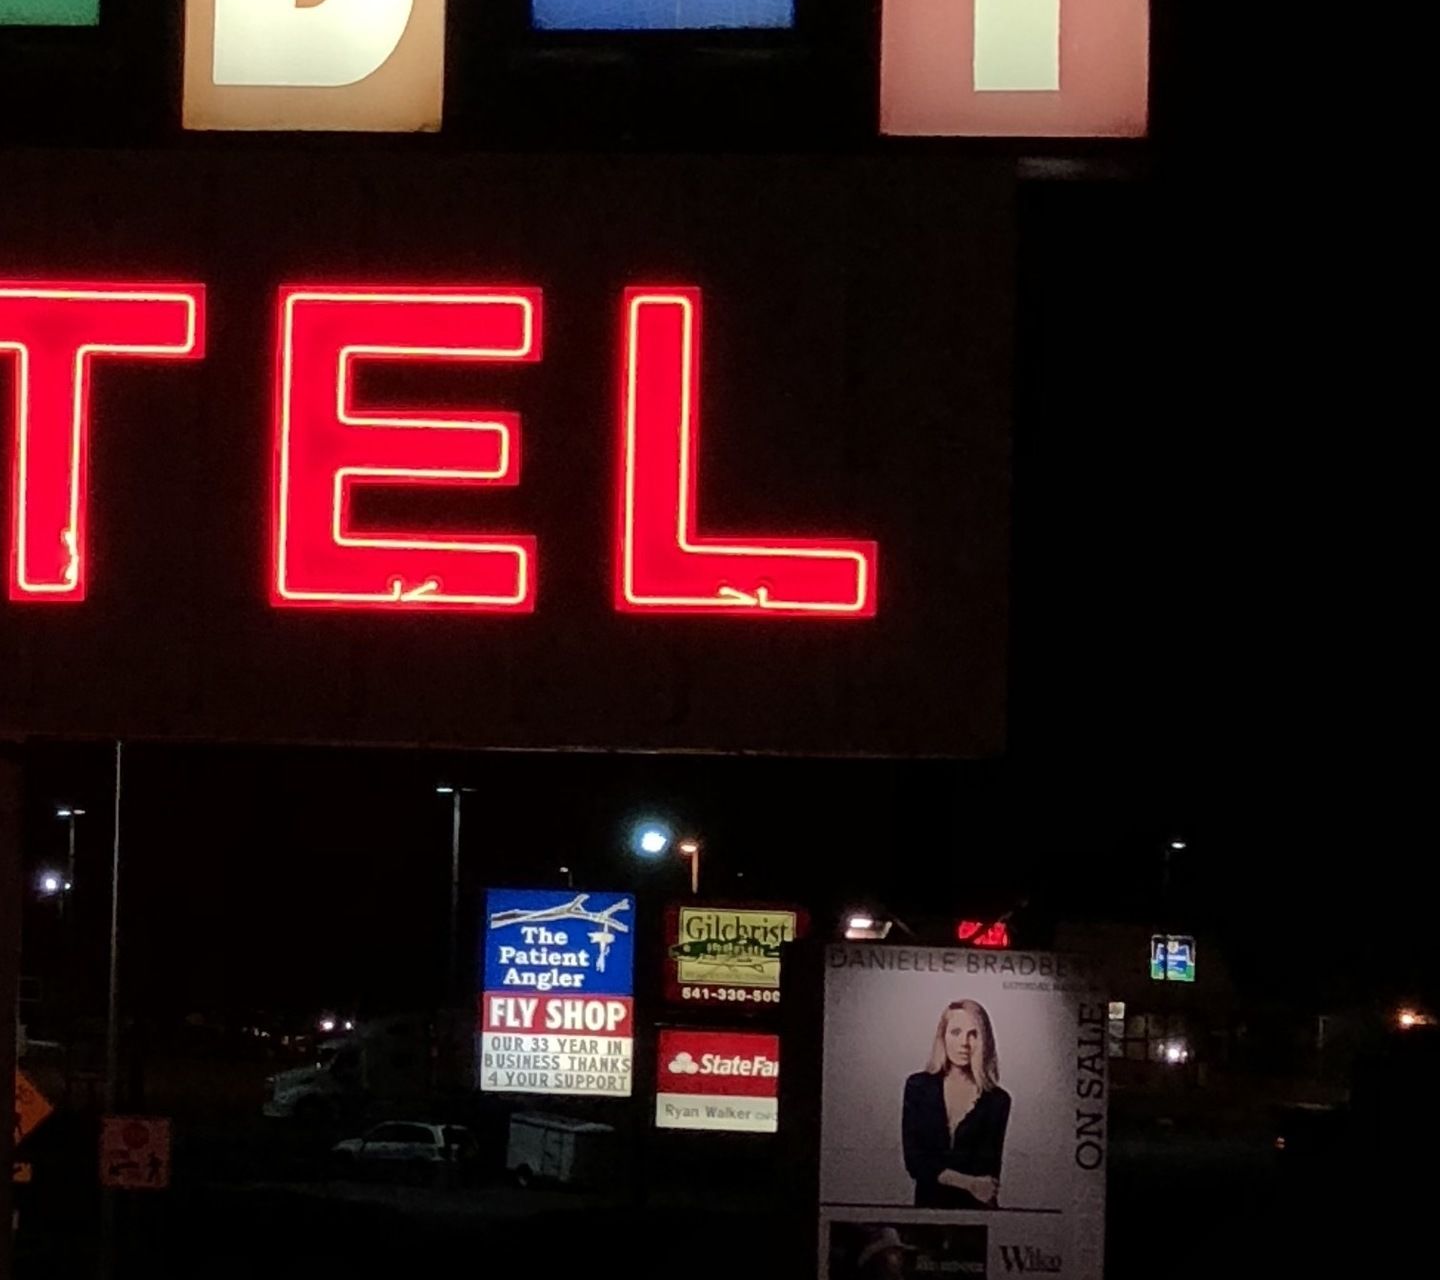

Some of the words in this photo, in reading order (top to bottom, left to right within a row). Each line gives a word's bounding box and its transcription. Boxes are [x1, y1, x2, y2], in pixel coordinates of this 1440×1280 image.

[521, 926, 568, 945] The
[686, 914, 789, 942] Gilchrist
[499, 947, 590, 967] Patient
[830, 948, 957, 973] DANIELLE
[503, 968, 585, 990] Angler
[489, 996, 539, 1028] FLY
[545, 999, 627, 1031] SHOP
[491, 1036, 524, 1051] OUR
[532, 1038, 549, 1052] 33
[557, 1038, 599, 1054] YEAR
[607, 1040, 622, 1054] IN
[1077, 1003, 1106, 1100] SALE
[484, 1053, 560, 1070] BUSINESS
[569, 1056, 631, 1073] THANKS
[488, 1073, 498, 1087] 4
[505, 1072, 549, 1088] YOUR
[554, 1073, 628, 1091] SUPPORT
[665, 1104, 699, 1120] Ryan
[706, 1105, 751, 1120] Walker
[1075, 1110, 1103, 1170] ON
